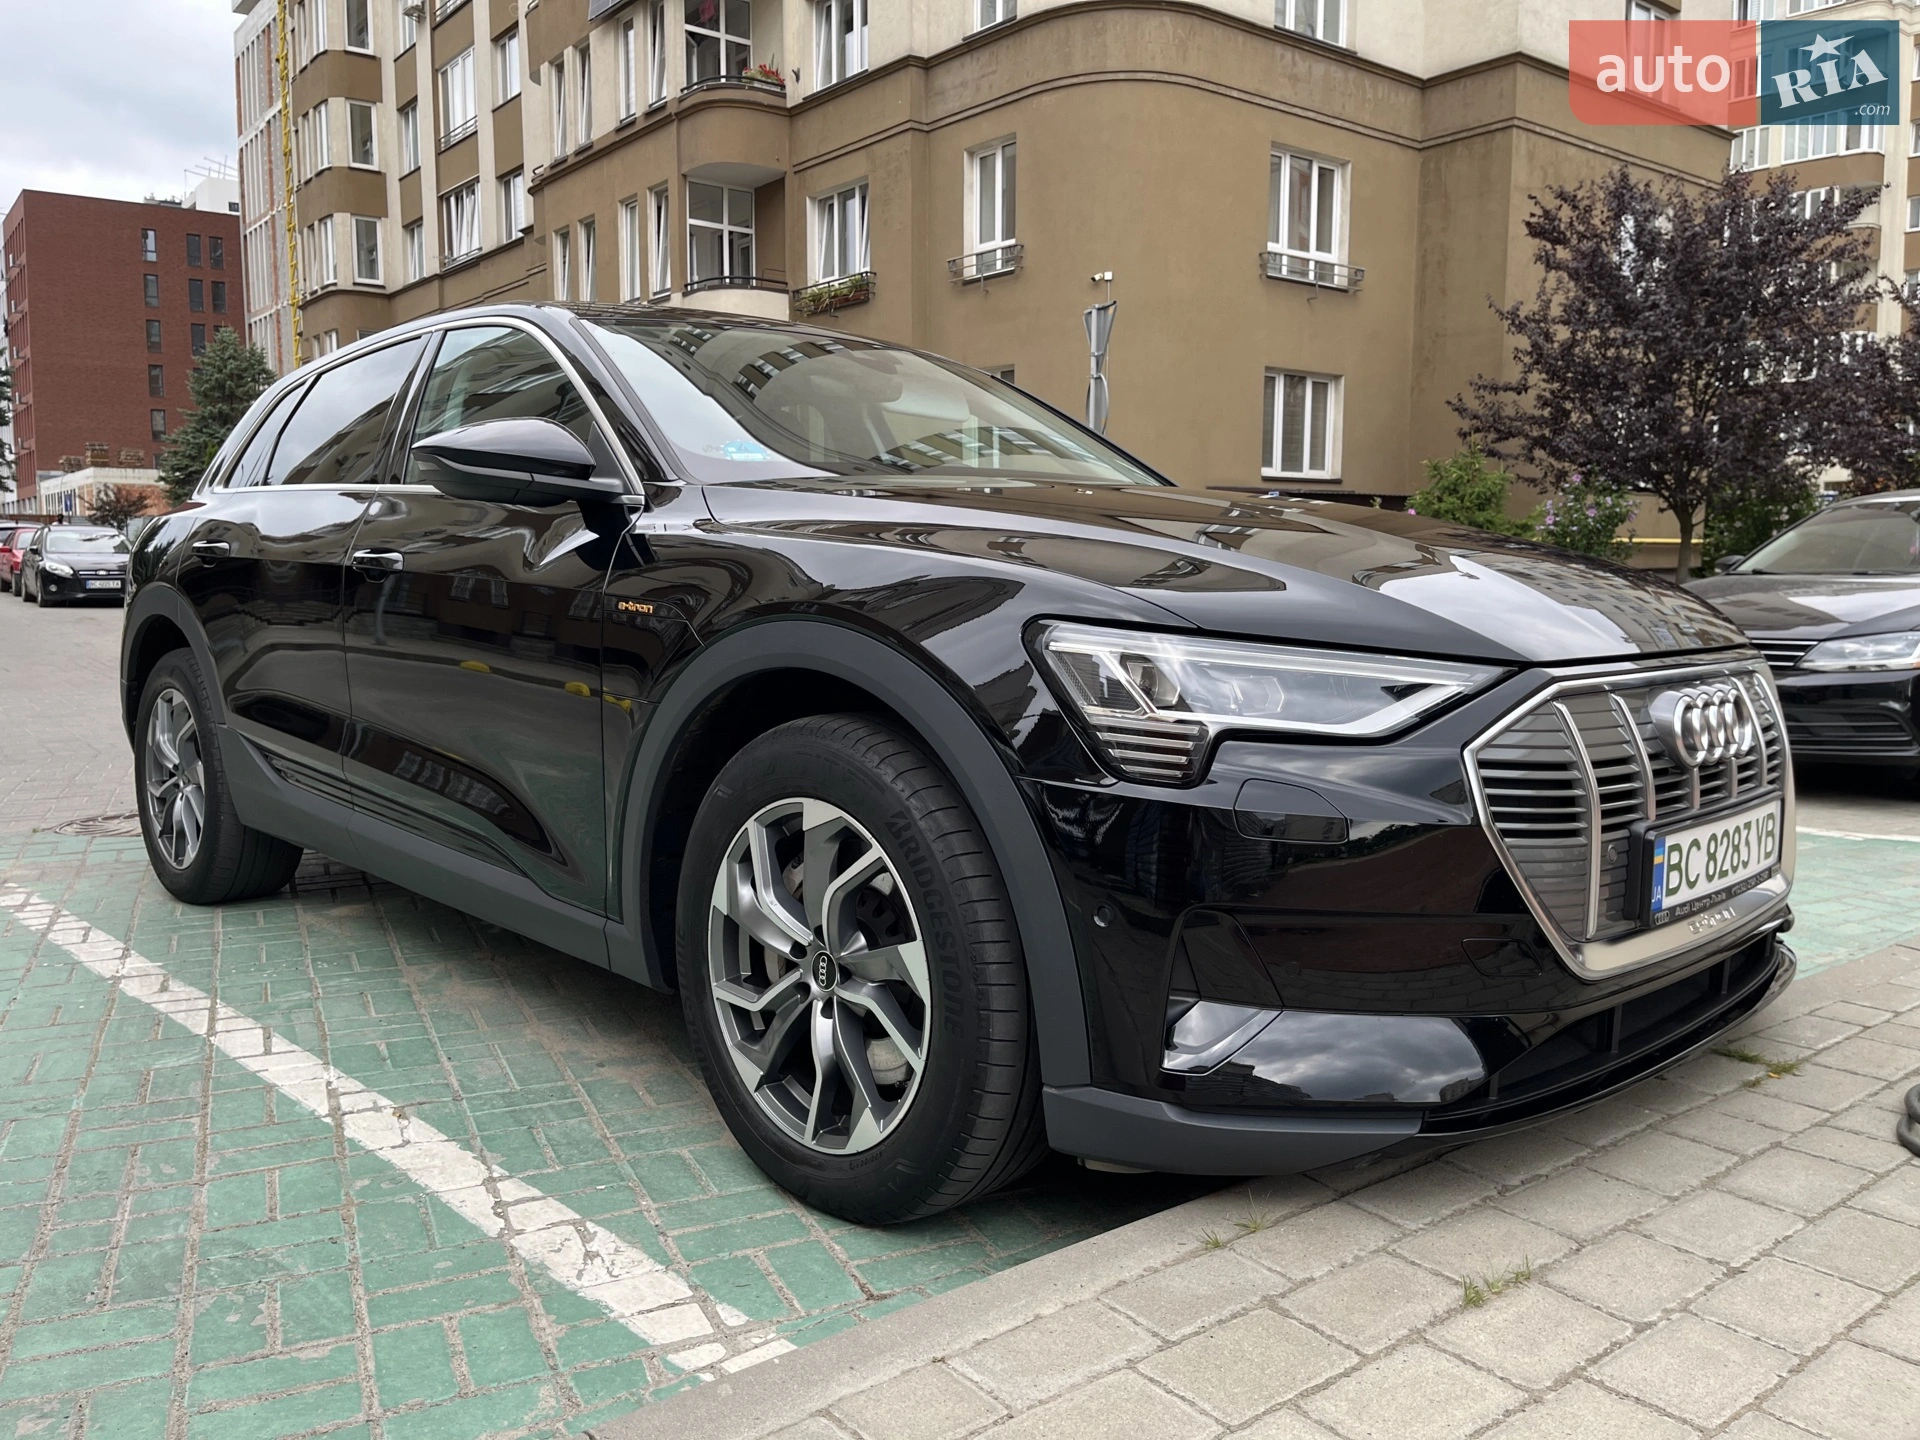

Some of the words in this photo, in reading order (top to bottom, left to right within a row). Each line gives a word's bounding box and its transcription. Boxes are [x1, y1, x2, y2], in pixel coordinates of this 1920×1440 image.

[618, 601, 654, 614] e-tron
[1665, 838, 1702, 898] BC
[1705, 820, 1752, 883] 8283
[1755, 812, 1776, 865] YB
[884, 809, 965, 1038] BRIDGESTONE
[1674, 903, 1691, 917] Audi
